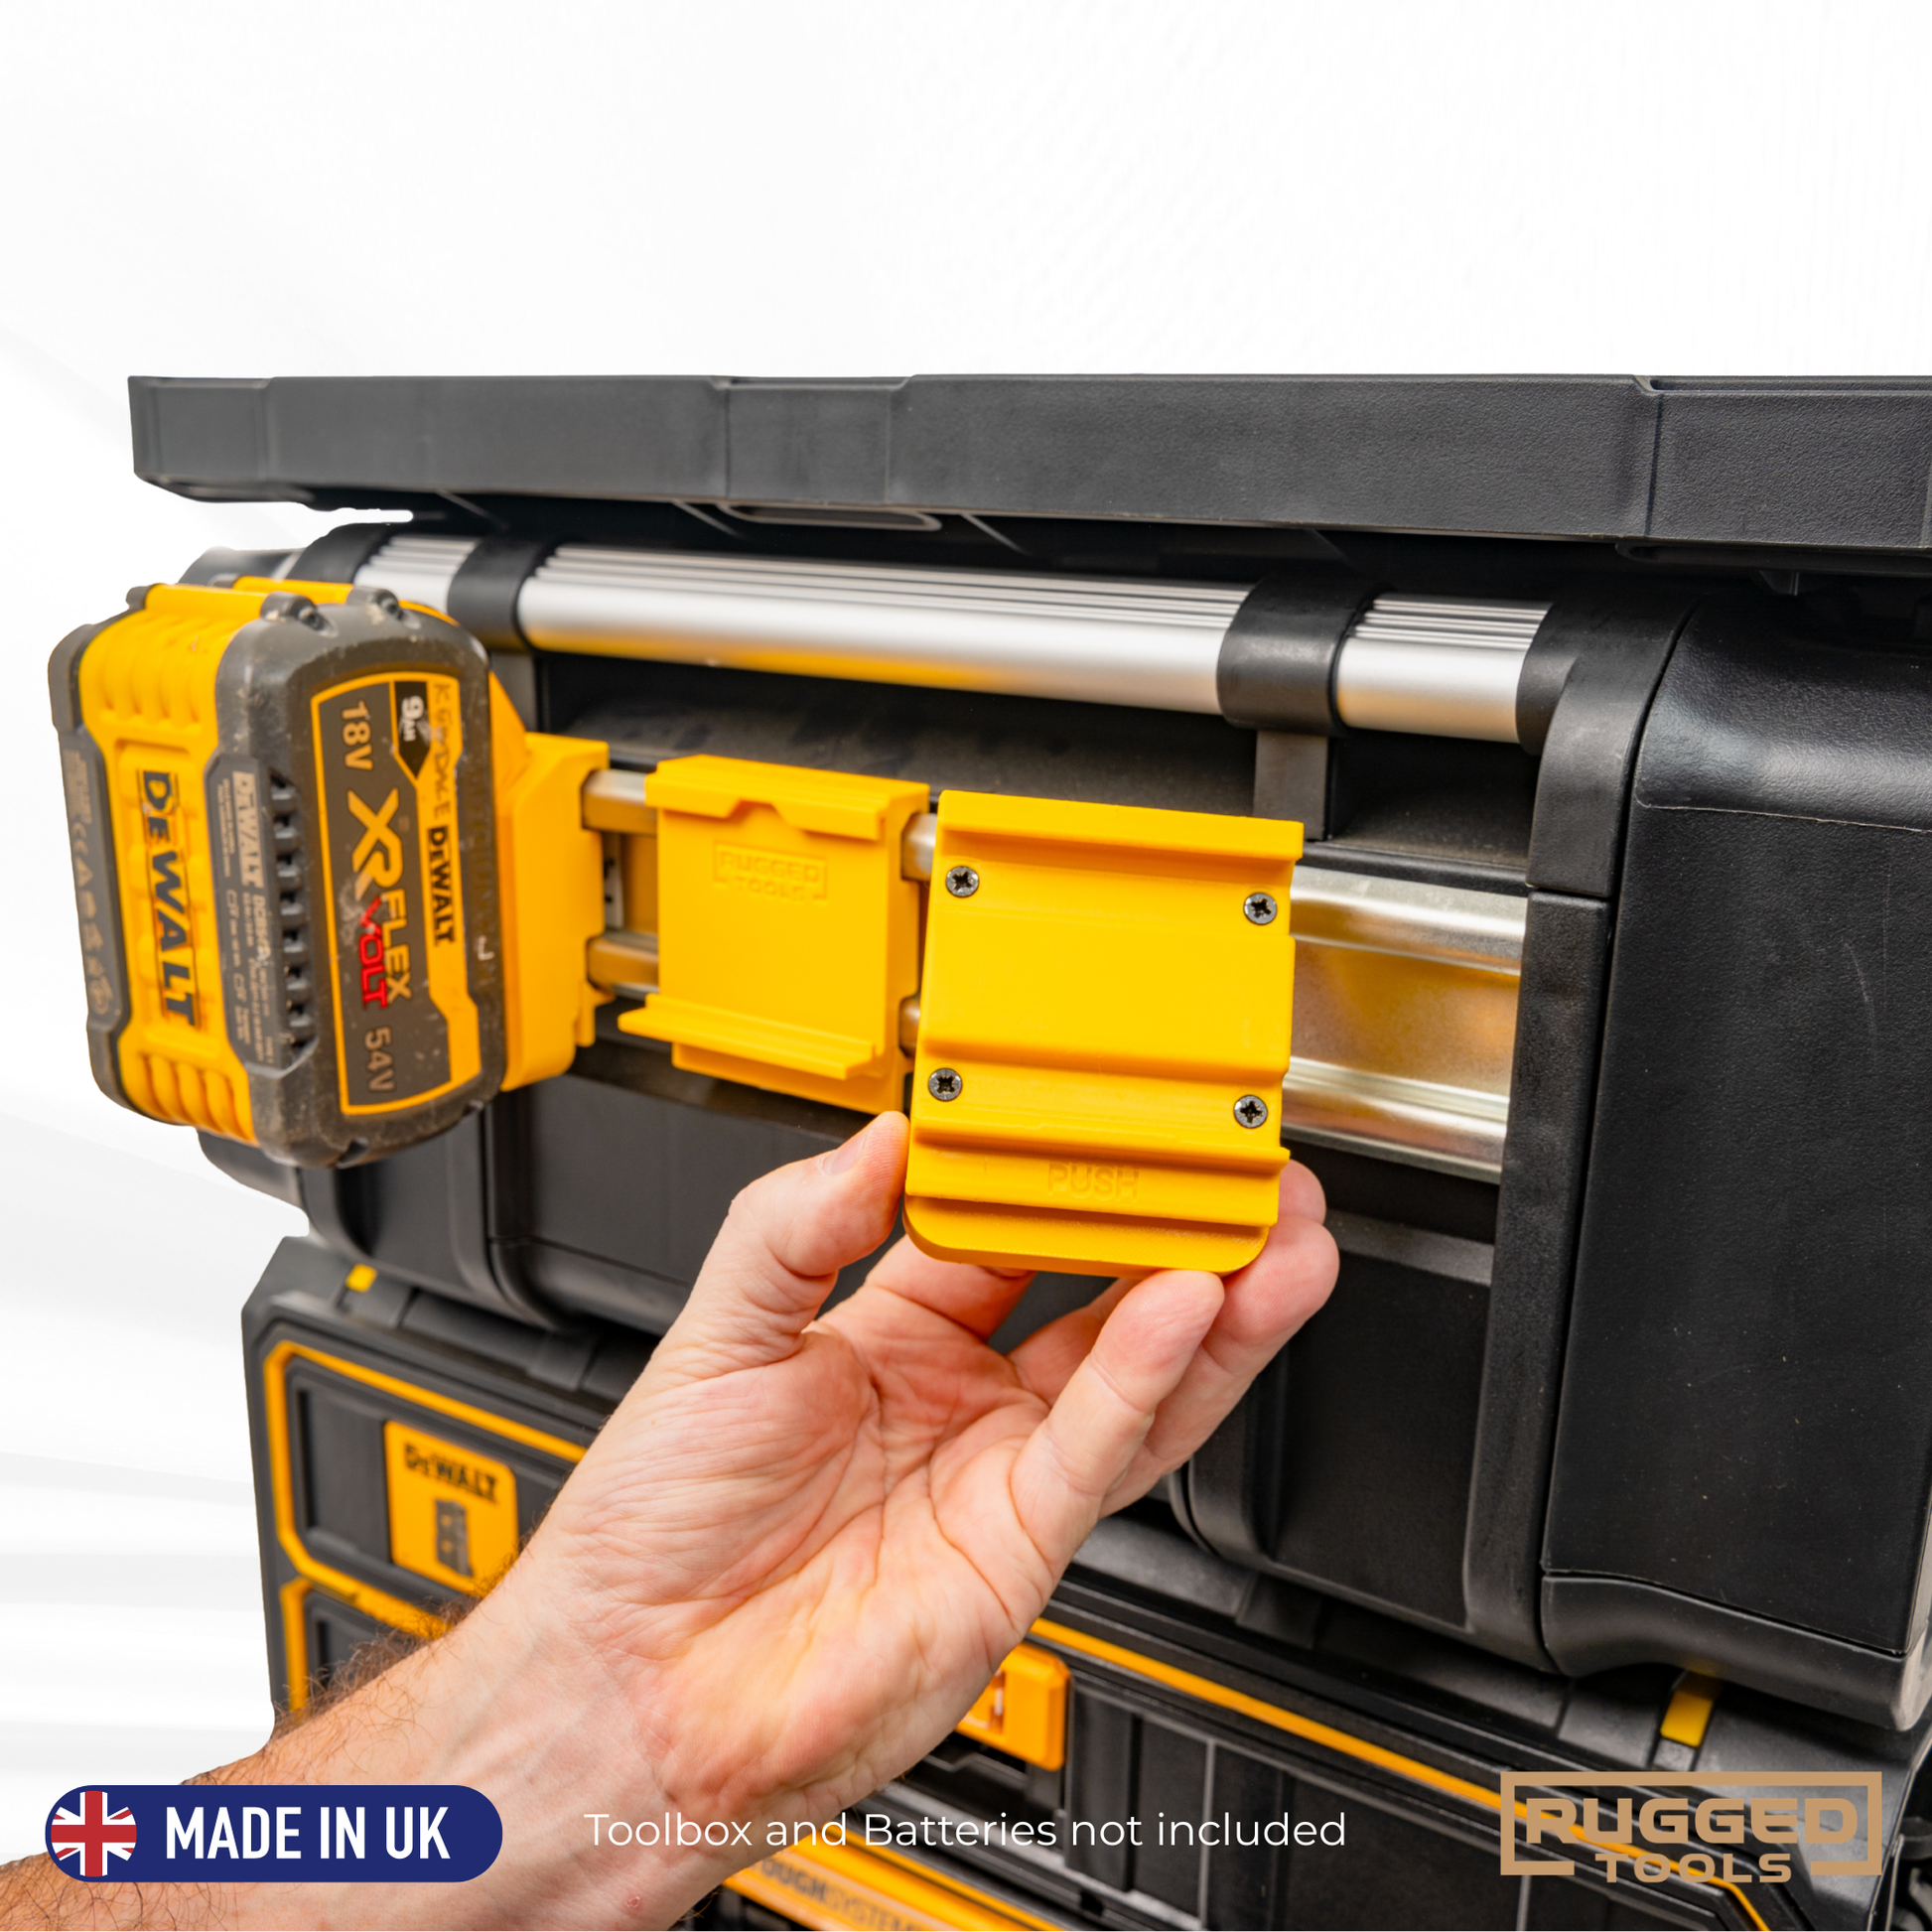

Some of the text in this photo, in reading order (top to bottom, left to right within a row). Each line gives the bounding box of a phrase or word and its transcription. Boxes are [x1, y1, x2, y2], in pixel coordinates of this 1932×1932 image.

[341, 700, 374, 771] 18V
[231, 769, 265, 890] DEWALT
[719, 851, 820, 883] RUGGED
[142, 769, 197, 1027] DEWALT
[428, 825, 458, 948] DEWALT
[358, 896, 389, 1010] VOLT
[380, 889, 412, 1002] FLEX
[364, 1026, 395, 1092] 54V
[1047, 1160, 1140, 1203] PUSH
[404, 1442, 498, 1504] DEWALT
